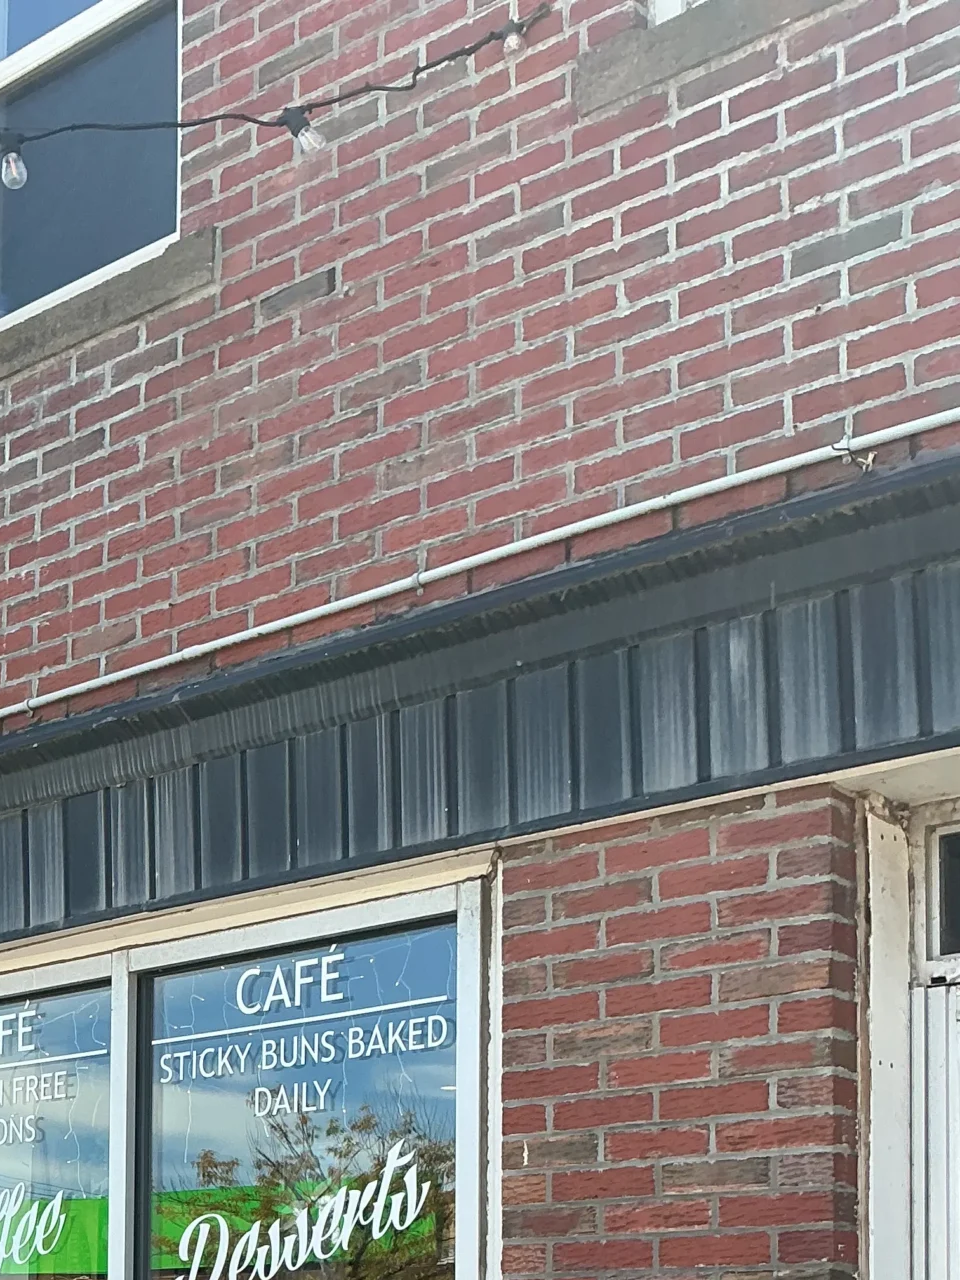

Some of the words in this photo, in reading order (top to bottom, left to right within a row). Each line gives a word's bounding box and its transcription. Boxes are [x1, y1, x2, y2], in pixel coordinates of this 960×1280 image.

[236, 943, 345, 1016] CAFÉ
[159, 1042, 252, 1084] STICKY
[260, 1030, 336, 1071] BUNS
[348, 1014, 448, 1059] BAKED
[12, 1070, 68, 1107] FREE
[253, 1078, 333, 1118] DAILY
